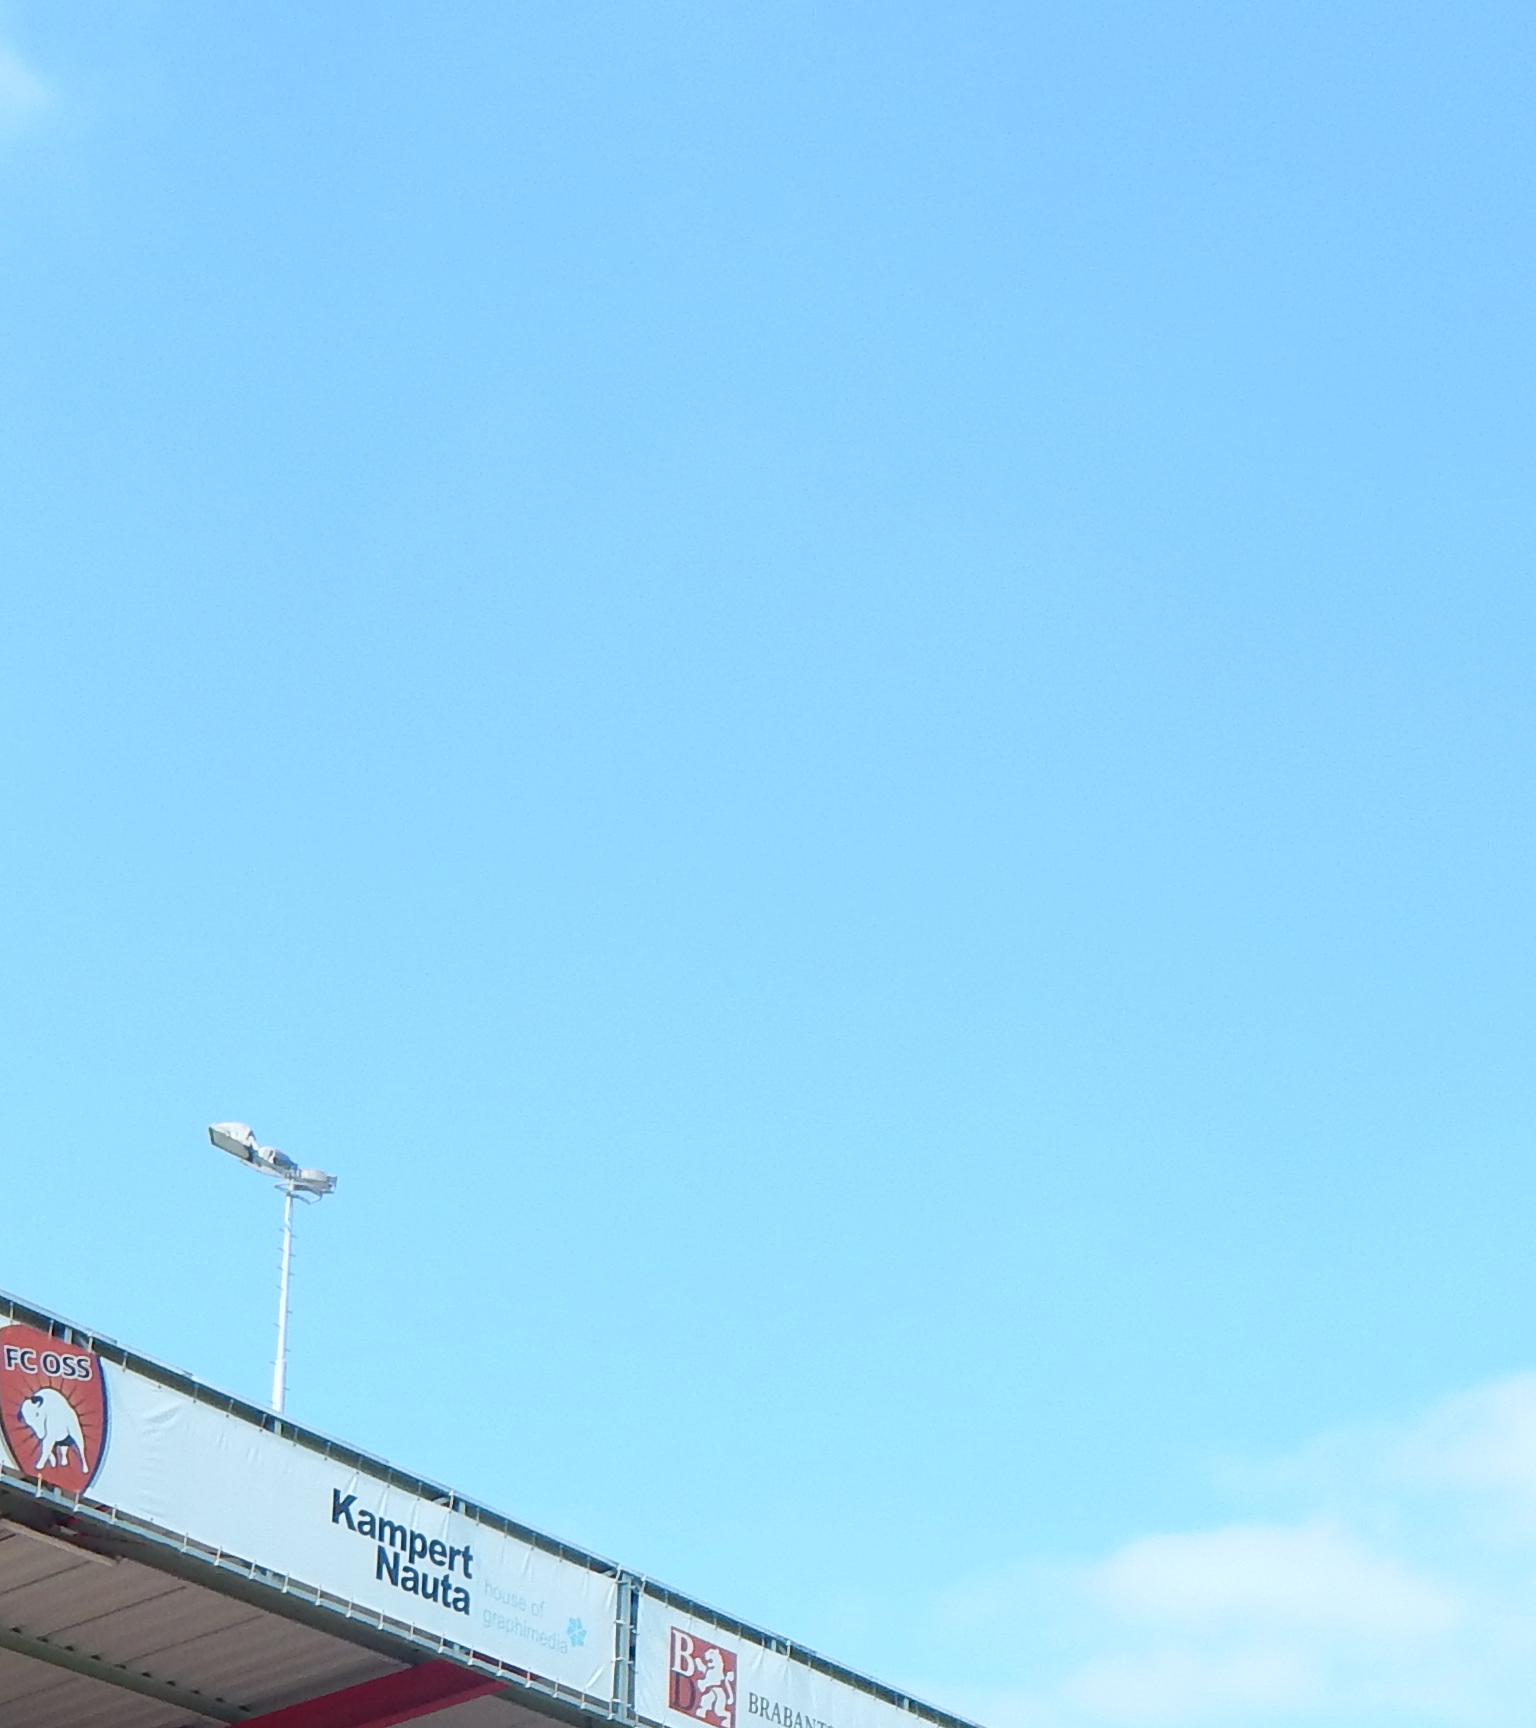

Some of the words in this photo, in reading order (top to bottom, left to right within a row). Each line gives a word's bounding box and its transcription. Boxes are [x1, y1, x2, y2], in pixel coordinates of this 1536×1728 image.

[4, 1345, 38, 1374] FC
[41, 1351, 93, 1381] OSS
[331, 1487, 474, 1580] Kampert
[375, 1544, 471, 1616] Nauta
[483, 1579, 527, 1611] house
[530, 1600, 545, 1619] of
[482, 1608, 569, 1654] graphimedia
[671, 1629, 696, 1678] B
